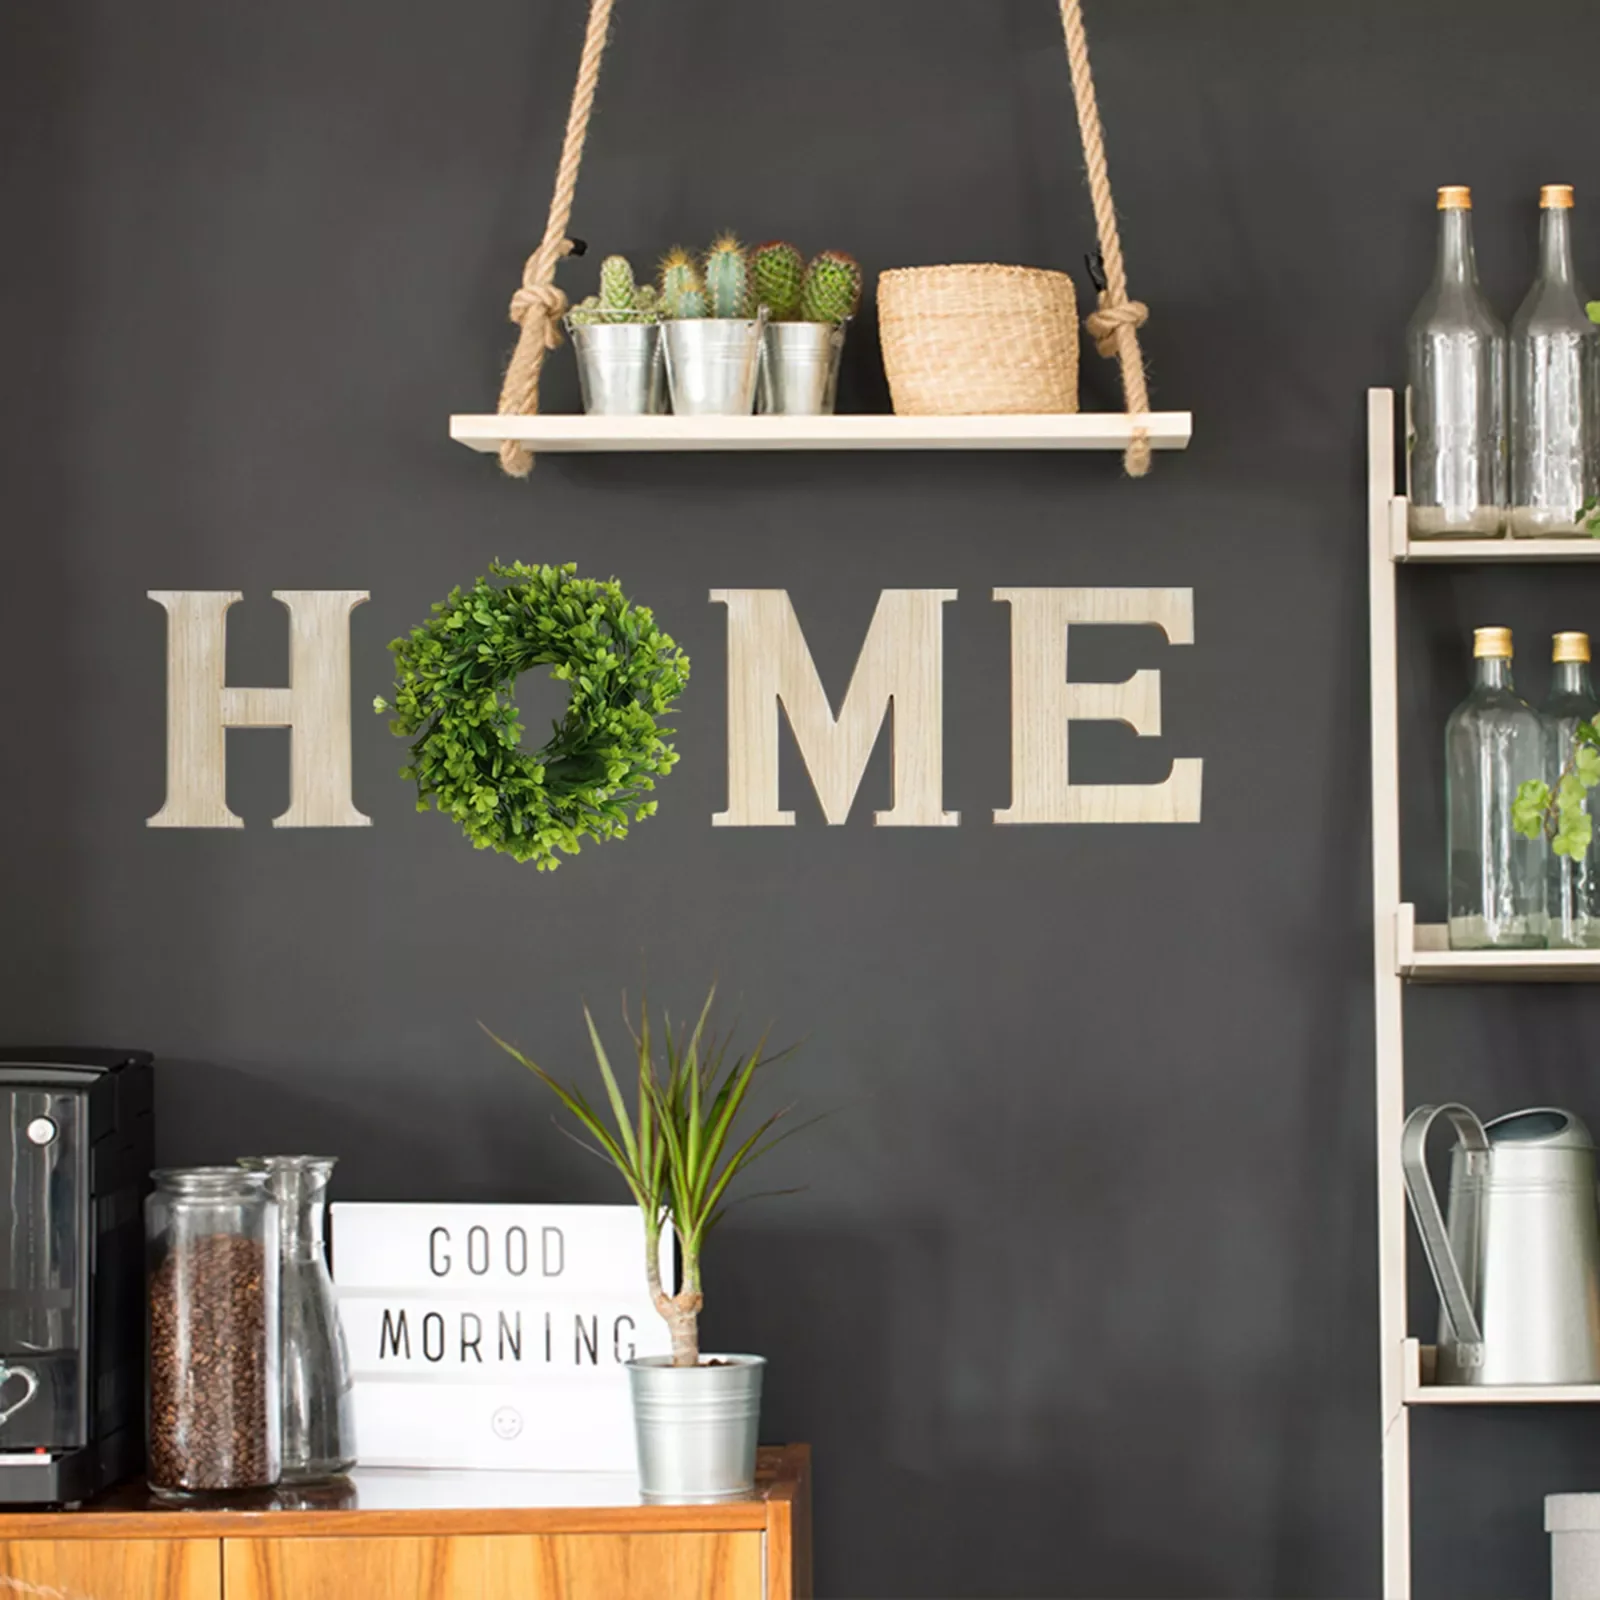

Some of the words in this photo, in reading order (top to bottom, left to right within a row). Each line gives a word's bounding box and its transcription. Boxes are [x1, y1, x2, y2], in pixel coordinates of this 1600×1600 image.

[146, 557, 1203, 872] HOME
[429, 1225, 565, 1277] GOOD
[379, 1308, 636, 1365] MORNING
